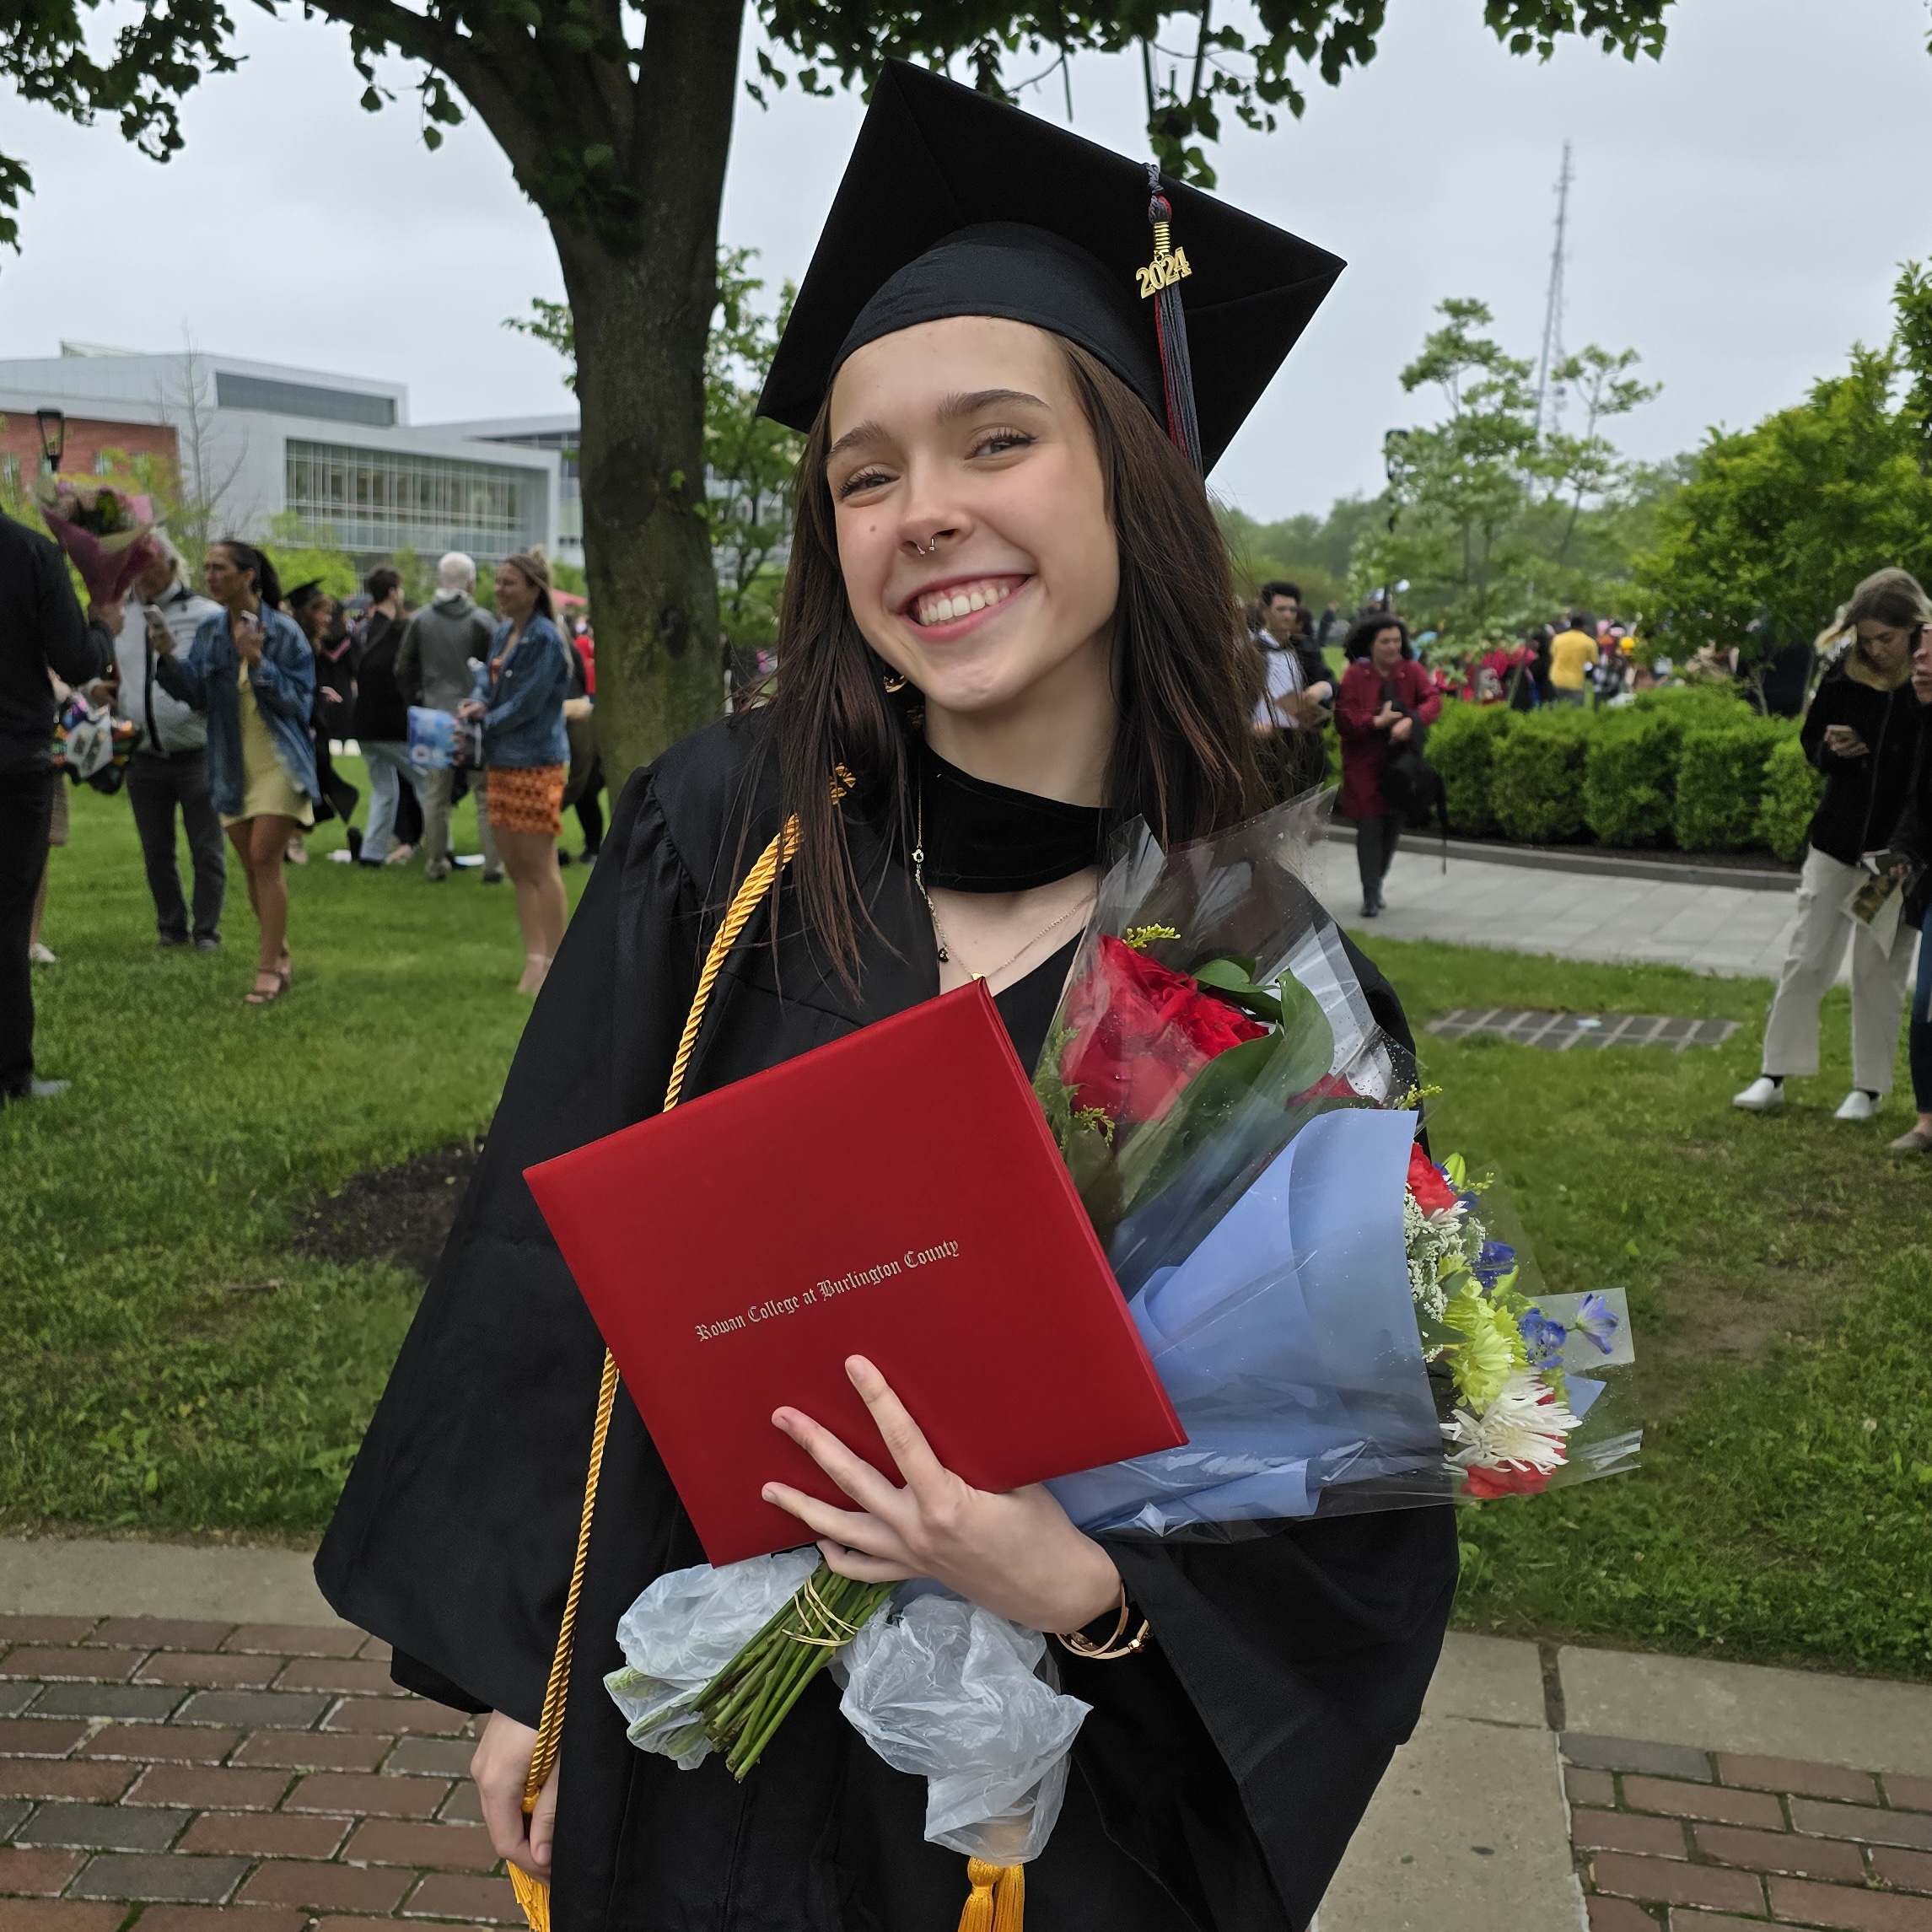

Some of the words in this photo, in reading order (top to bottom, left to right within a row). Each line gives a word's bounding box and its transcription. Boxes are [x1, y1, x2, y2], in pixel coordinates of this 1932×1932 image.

[1135, 245, 1192, 299] 2024
[694, 1314, 747, 1343] Rowan
[747, 1300, 800, 1322] College
[802, 1288, 818, 1305] at
[816, 1261, 902, 1302] Burlington
[903, 1240, 960, 1268] County
